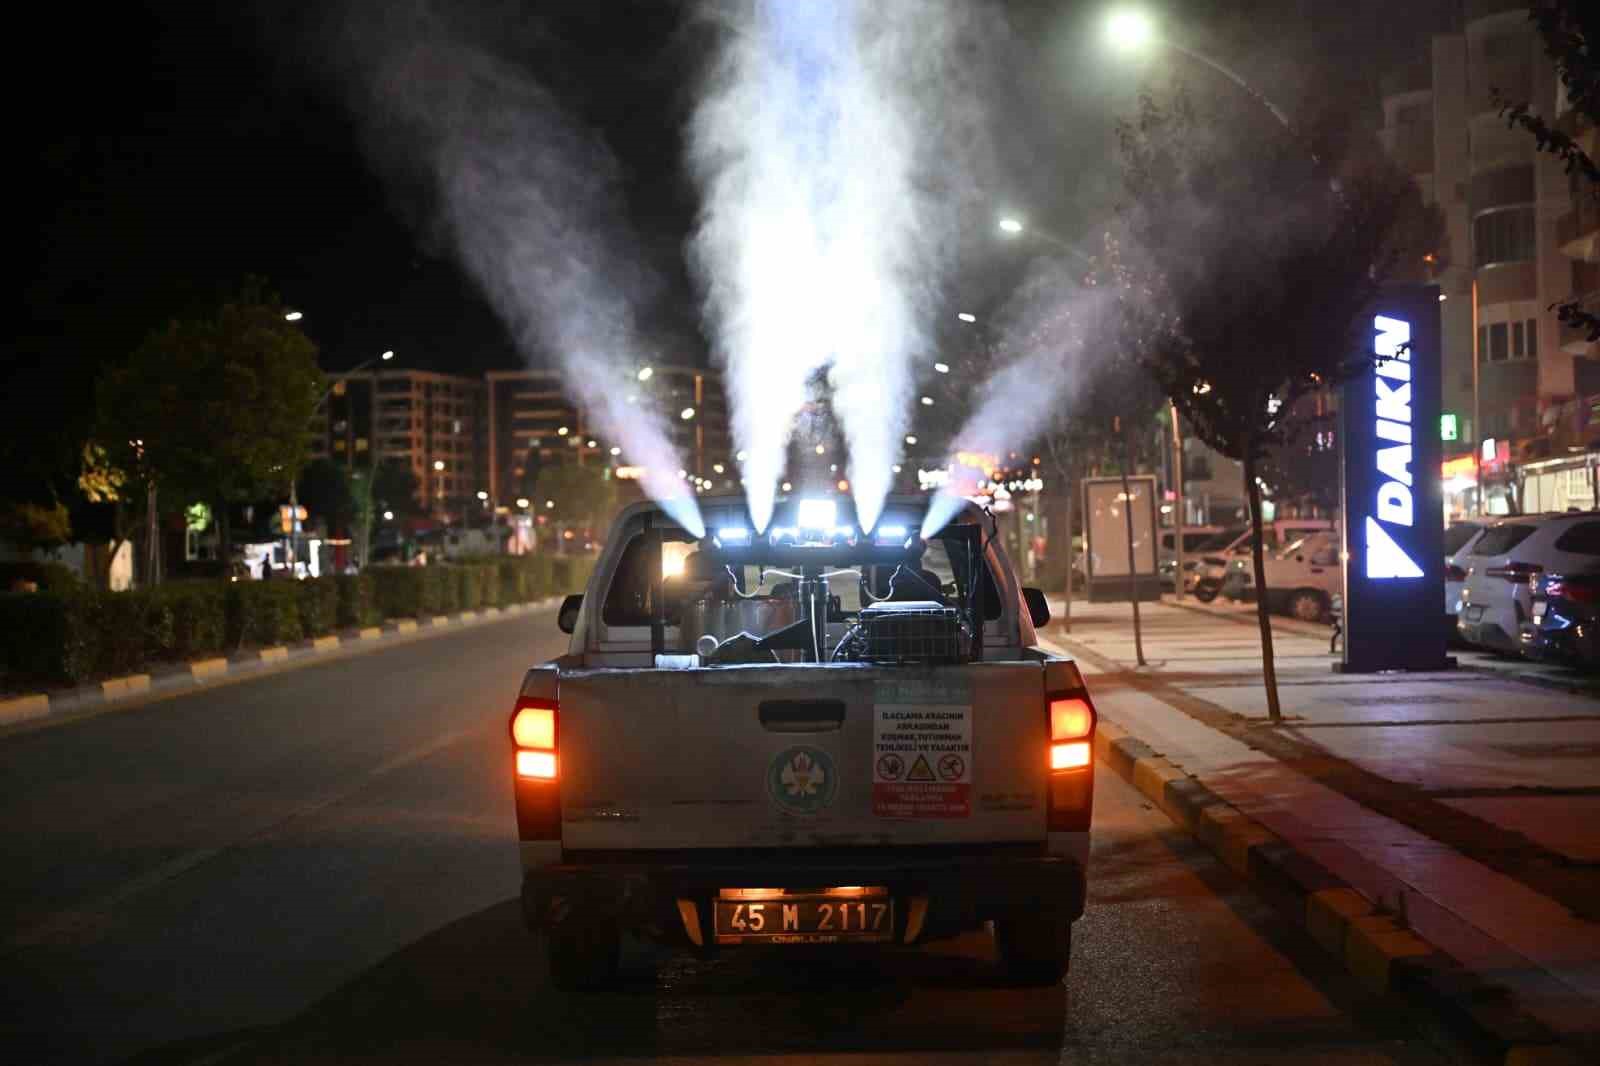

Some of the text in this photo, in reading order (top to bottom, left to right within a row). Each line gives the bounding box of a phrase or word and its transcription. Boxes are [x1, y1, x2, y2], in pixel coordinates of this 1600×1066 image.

[1374, 315, 1413, 527] DAIKIN
[731, 903, 887, 930] 45 M 2117
